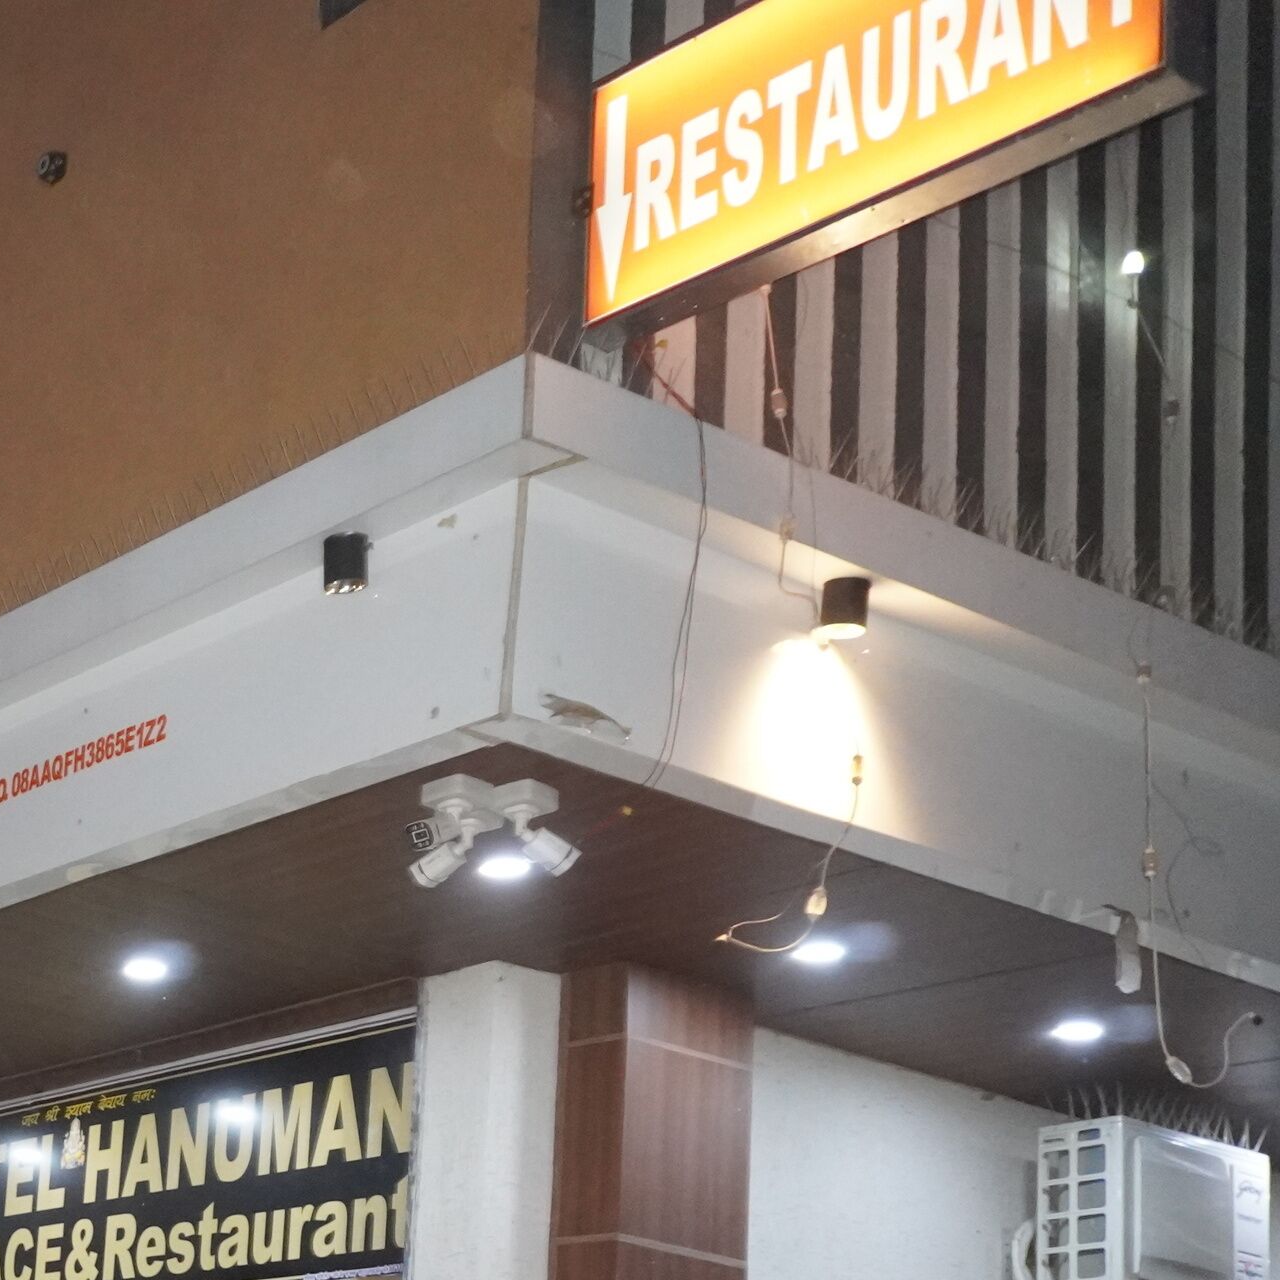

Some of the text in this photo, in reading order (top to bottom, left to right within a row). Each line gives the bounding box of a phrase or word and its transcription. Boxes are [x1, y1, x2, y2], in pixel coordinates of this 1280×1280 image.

[633, 0, 1132, 251] RESTAURAN
[12, 714, 167, 797] 08AAQFH3865E1Z2
[45, 1105, 61, 1122] श्री
[83, 1061, 415, 1205] HANUMAN
